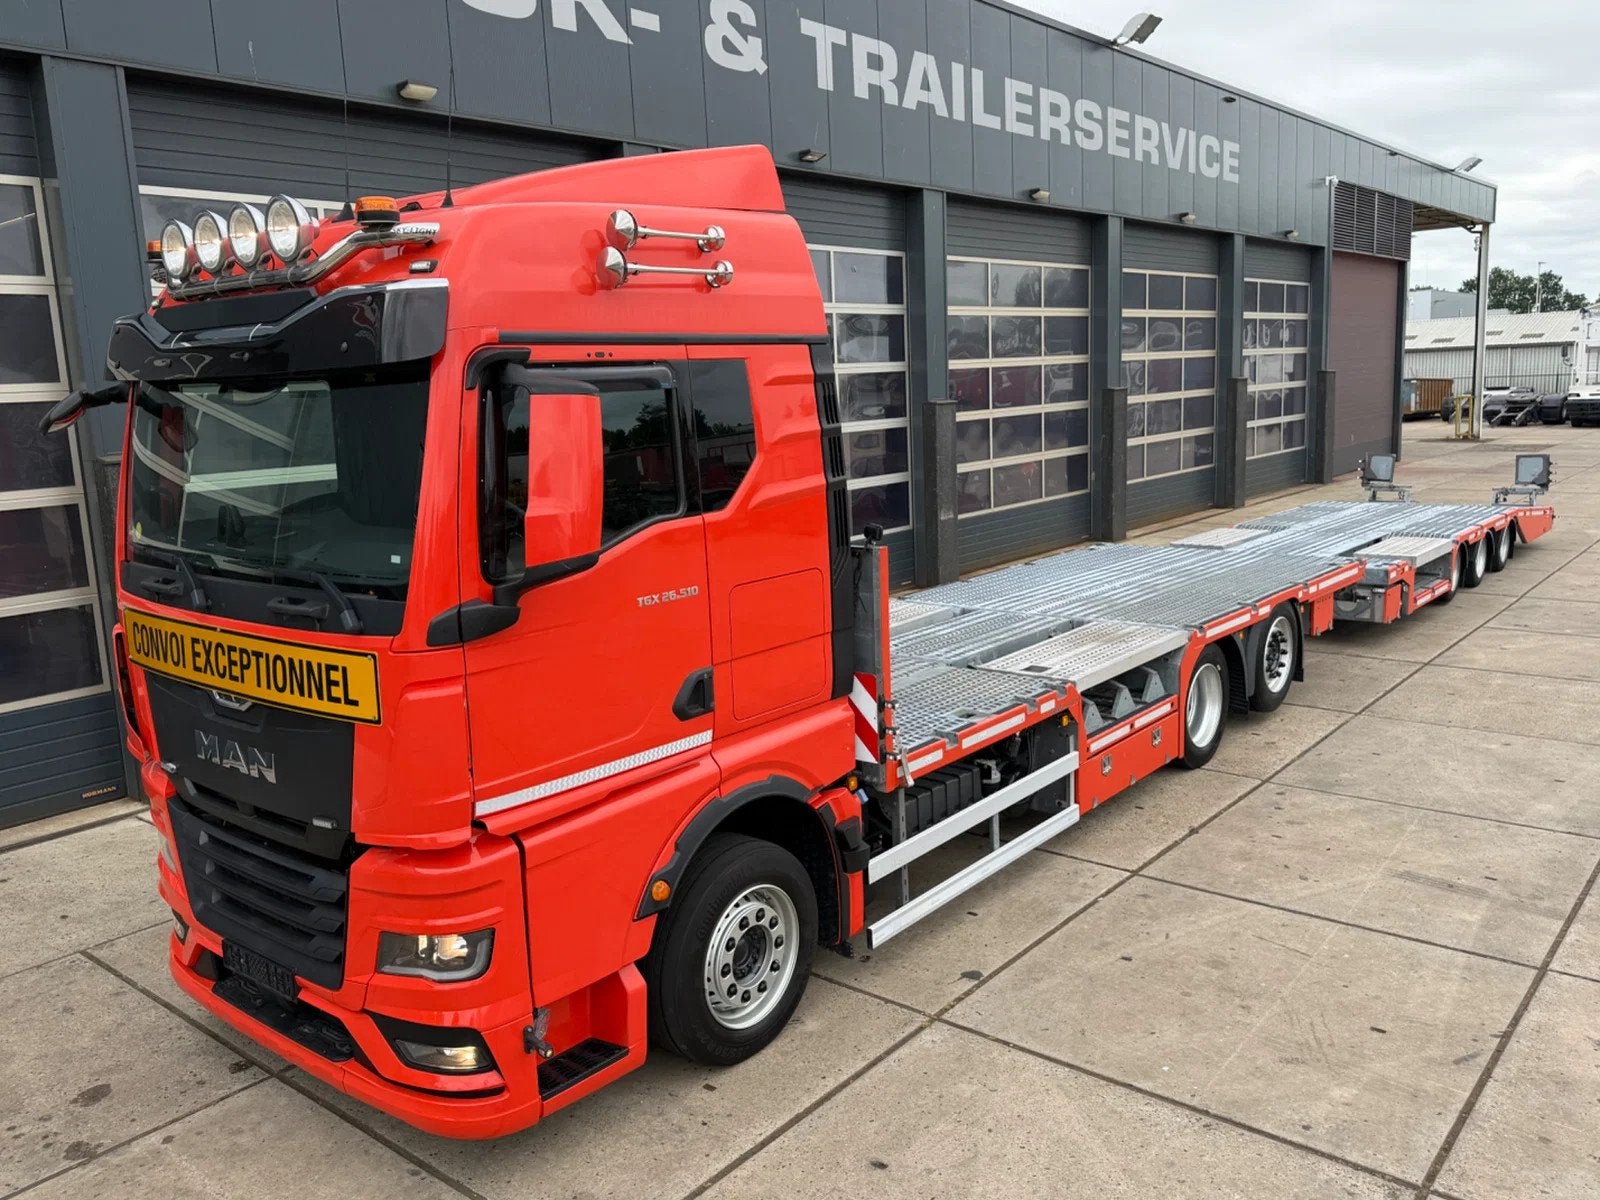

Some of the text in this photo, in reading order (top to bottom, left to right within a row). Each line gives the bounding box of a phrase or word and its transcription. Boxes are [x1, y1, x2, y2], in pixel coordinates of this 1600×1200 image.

[704, 0, 769, 76] &
[800, 17, 1240, 184] TRAILERSERVICE
[636, 585, 699, 608] TGX 26.510
[132, 621, 360, 707] CONVOI EXCEPTIONNEL
[194, 729, 277, 785] MAN
